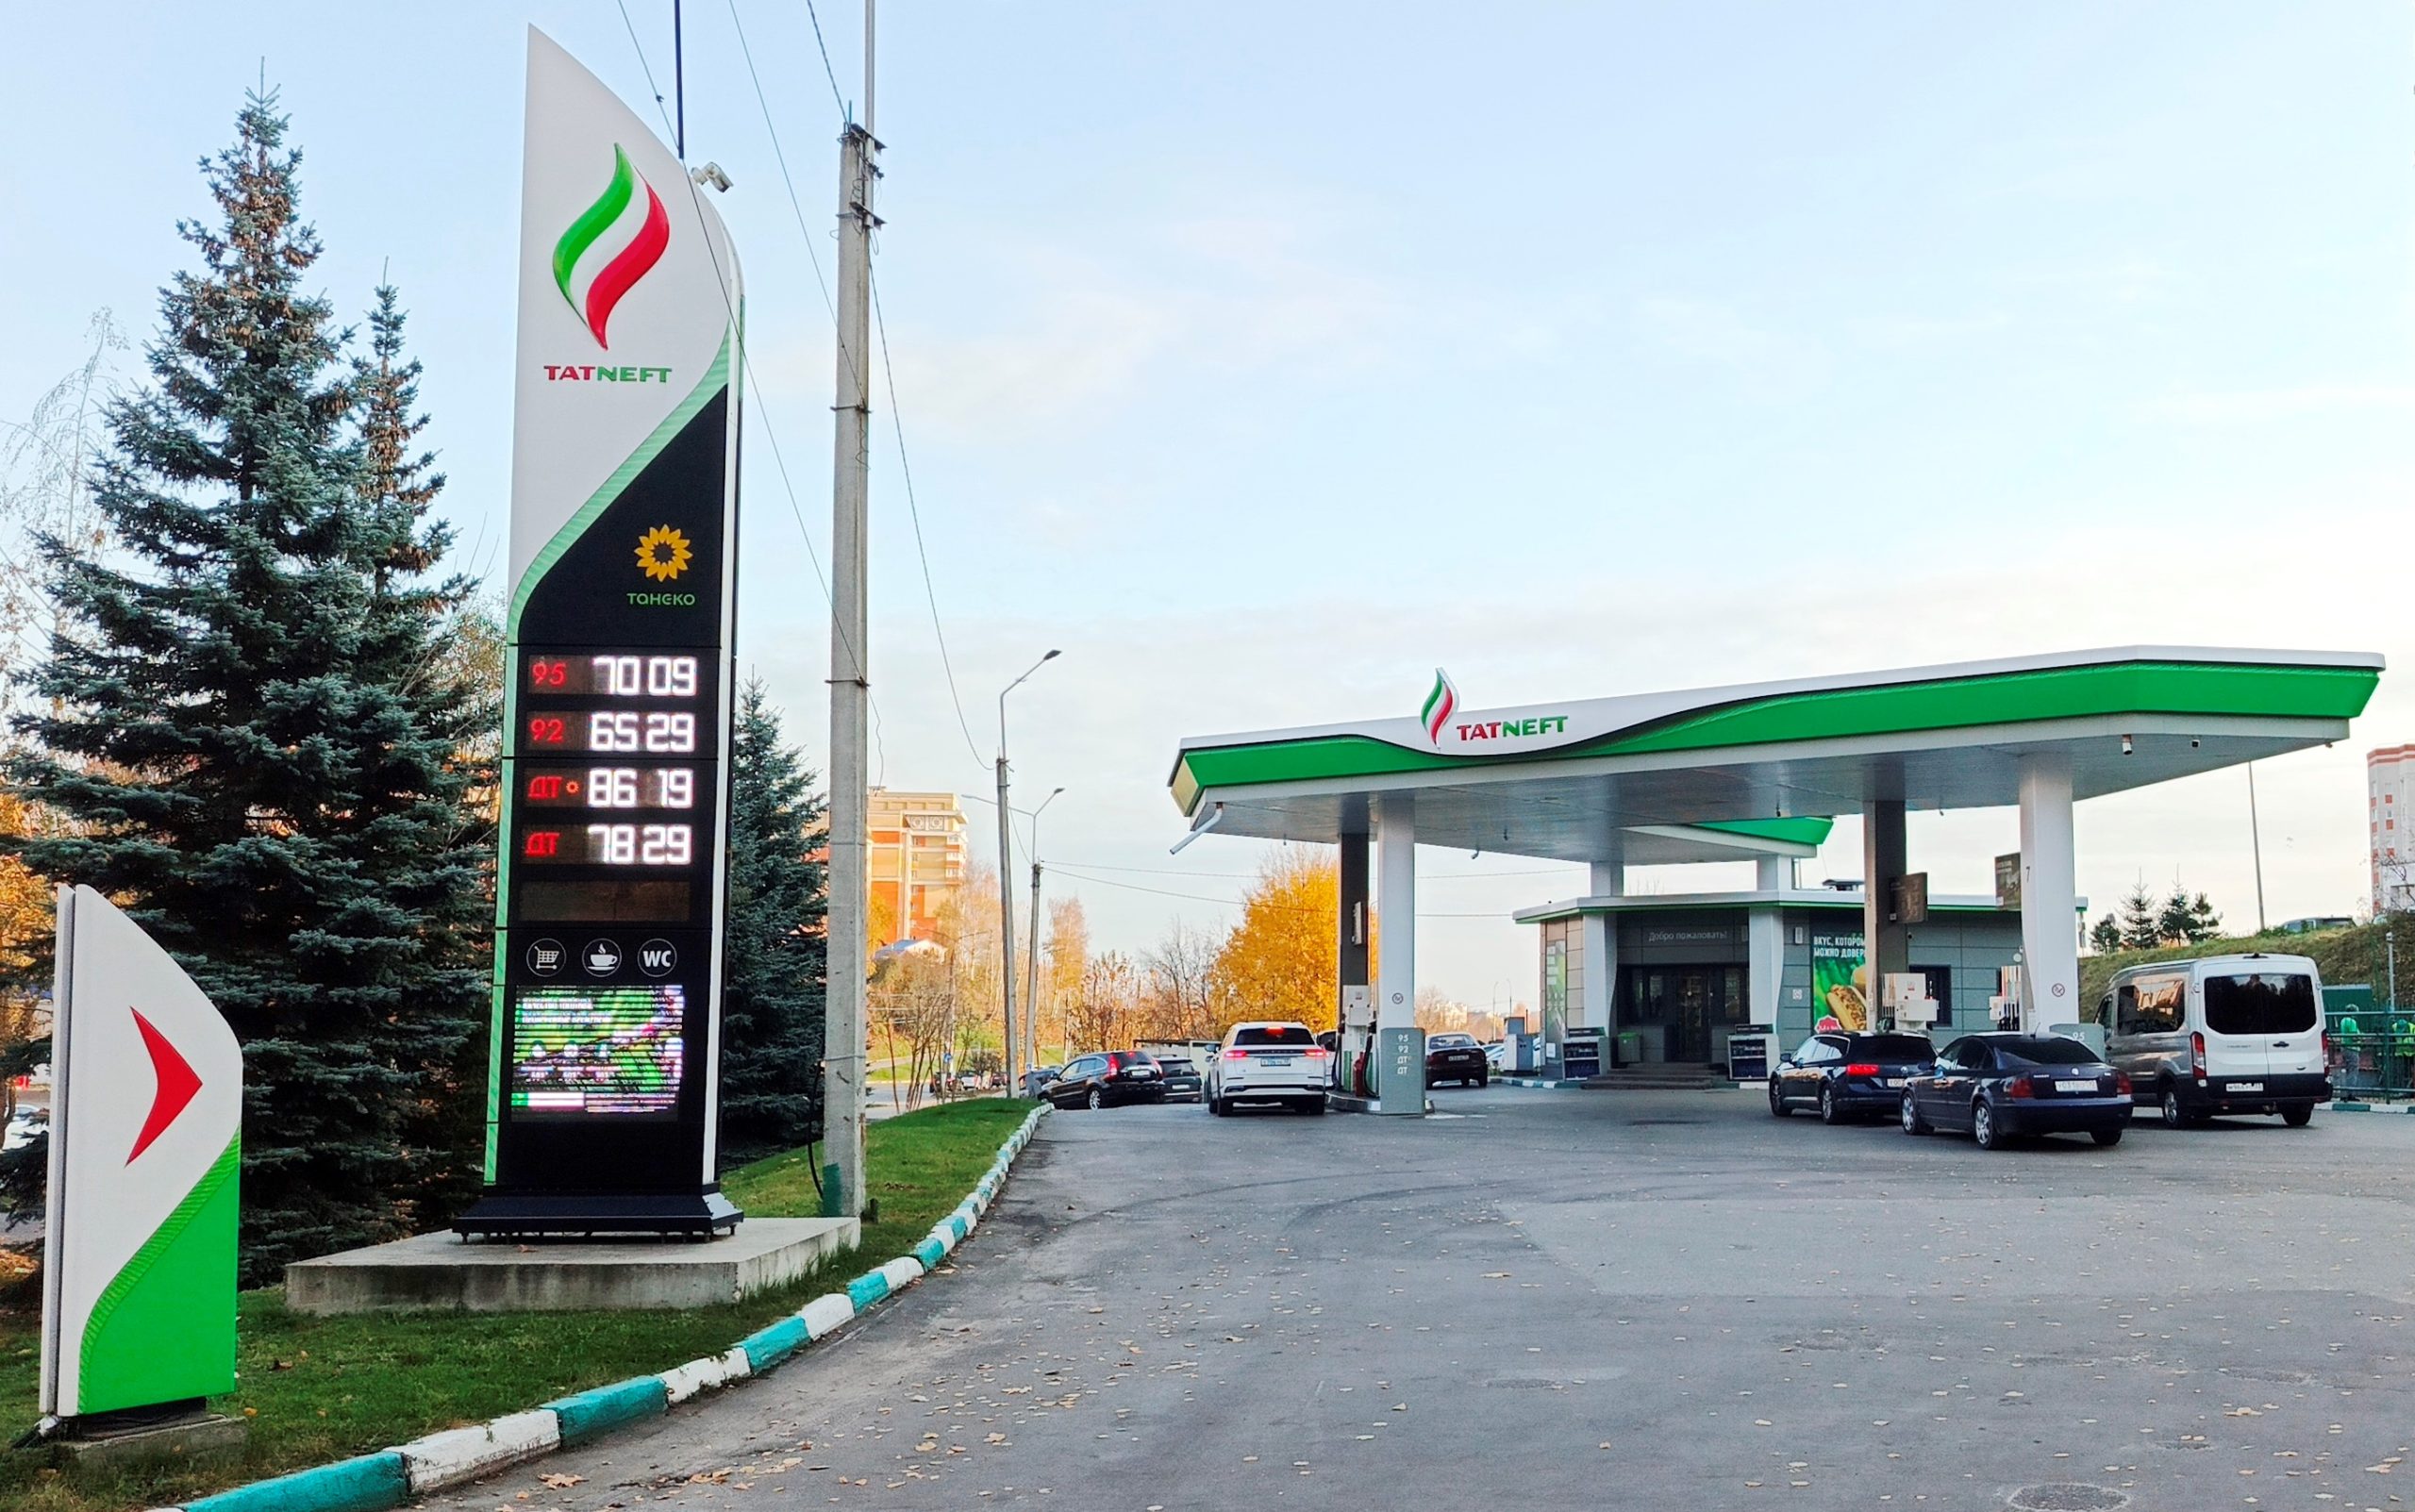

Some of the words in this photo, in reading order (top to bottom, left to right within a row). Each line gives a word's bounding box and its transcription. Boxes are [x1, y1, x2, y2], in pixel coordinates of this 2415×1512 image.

[543, 365, 673, 383] TATNEFT
[531, 662, 566, 686] 95
[530, 718, 564, 743] 92
[1457, 715, 1569, 741] TATNEFT
[527, 775, 562, 799] ДТ
[525, 831, 560, 857] ДТ
[1649, 931, 1674, 941] Добро
[643, 950, 672, 968] WC
[1813, 947, 1840, 957] МОЖНО
[1840, 948, 1866, 958] ДОВЕР
[1397, 1034, 1409, 1042] 95
[2072, 1031, 2086, 1040] 95
[1397, 1045, 1409, 1054] 92
